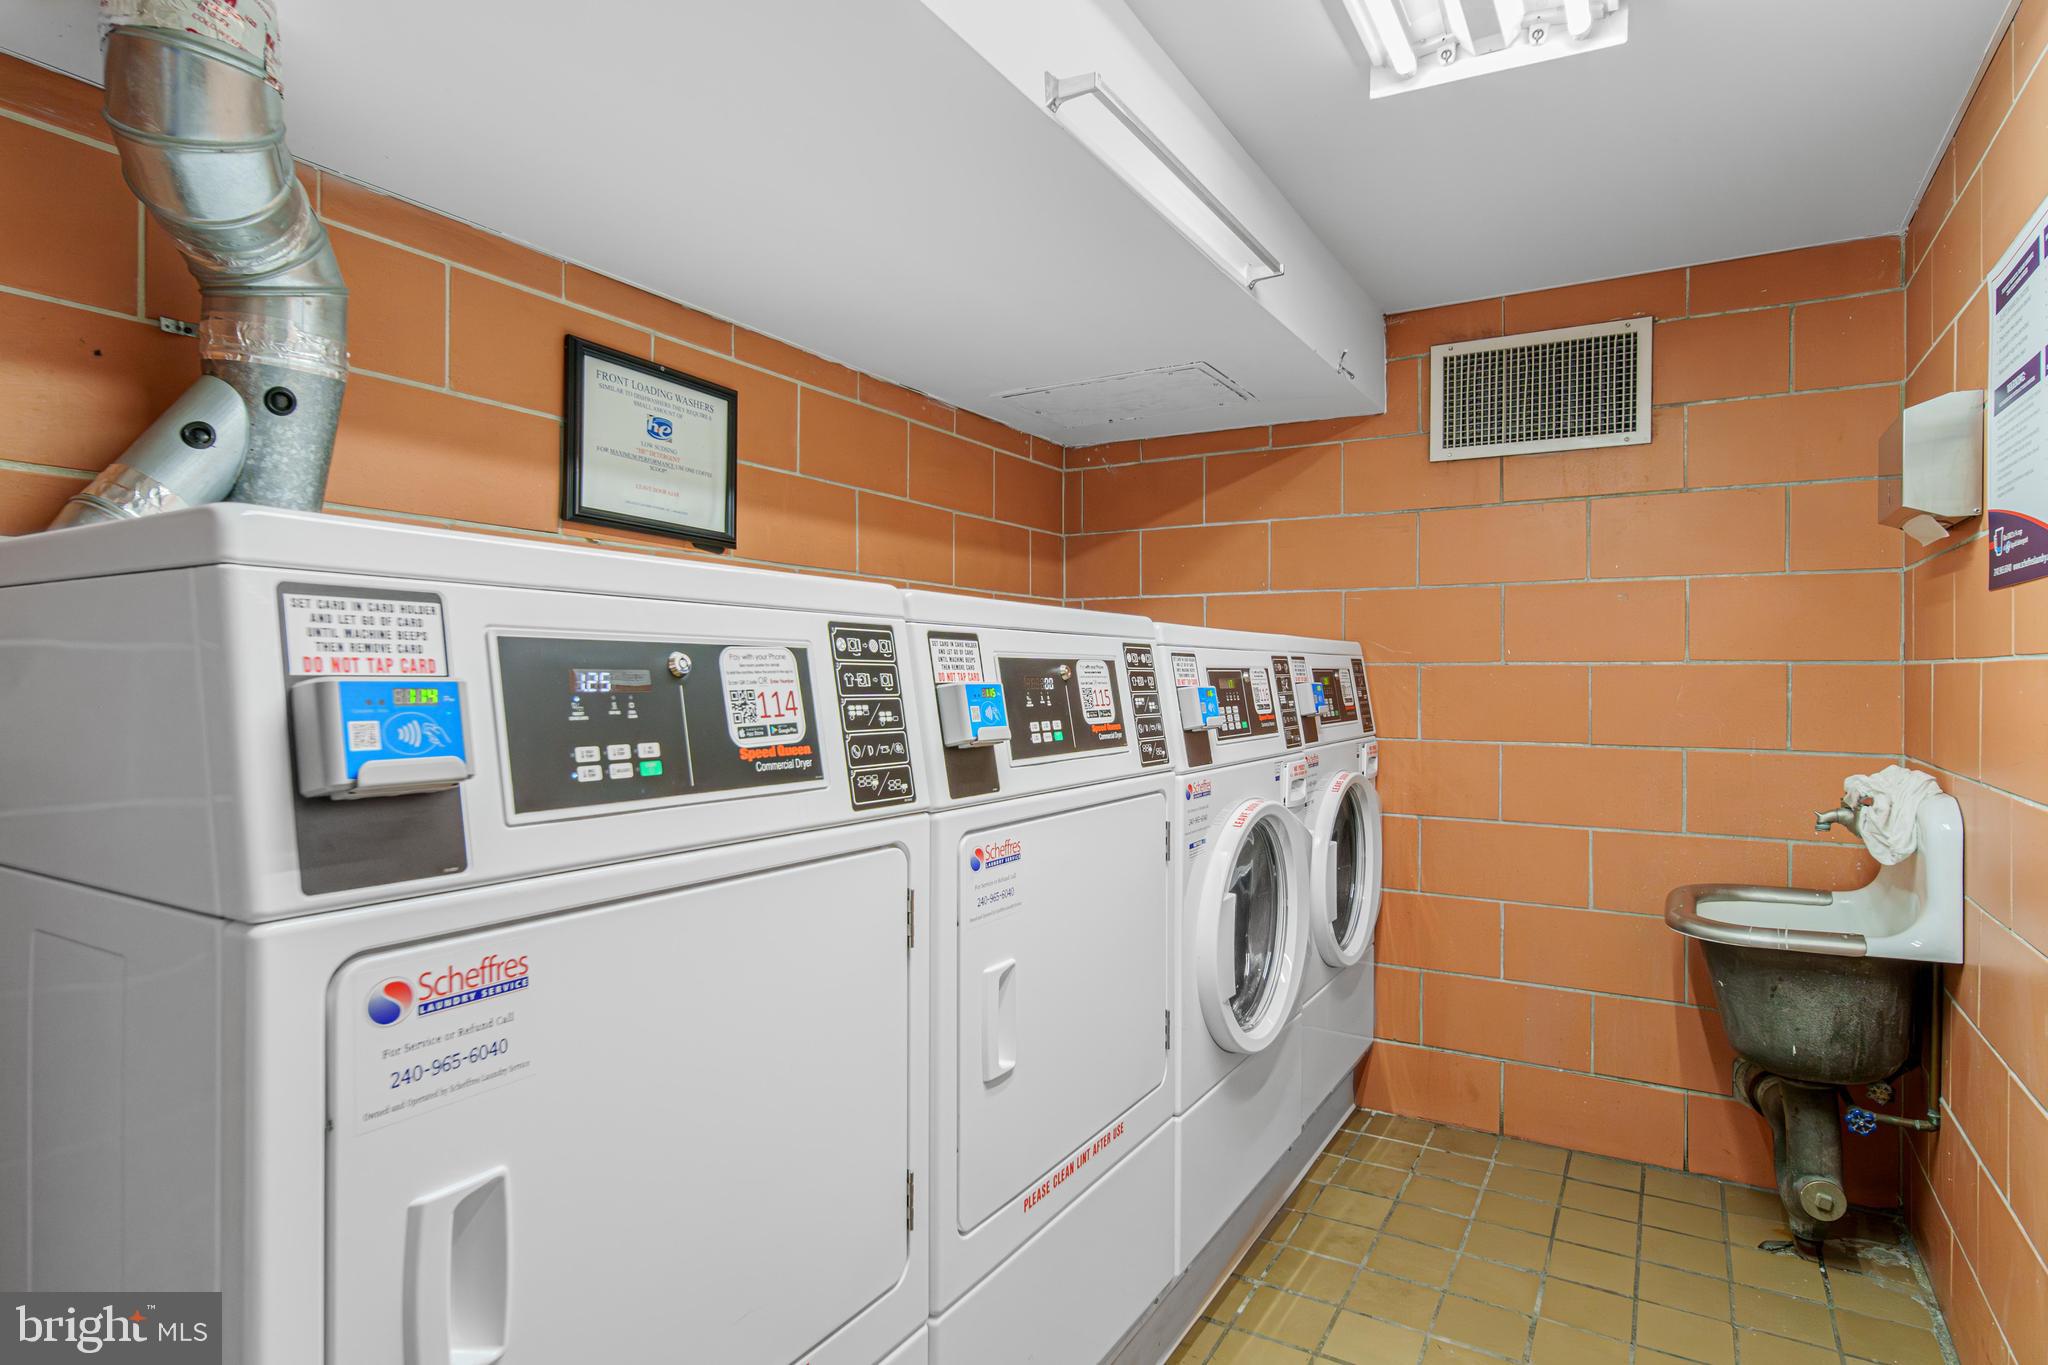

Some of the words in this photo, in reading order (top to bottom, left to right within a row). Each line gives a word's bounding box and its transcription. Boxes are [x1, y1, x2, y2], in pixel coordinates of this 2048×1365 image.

[596, 369, 629, 386] FRONT
[632, 380, 673, 400] LOADING
[675, 393, 714, 413] WASHERS
[599, 383, 623, 394] SIMILAR
[633, 400, 652, 411] SMALL
[596, 445, 609, 453] FOR
[610, 448, 637, 460] MAXIMUM
[289, 598, 310, 608] SET
[317, 599, 346, 611] CARD
[352, 601, 362, 611] IN
[367, 602, 394, 613] CARD
[400, 604, 436, 615] HOLDER
[310, 613, 332, 624] AND
[337, 614, 356, 625] LET
[362, 615, 375, 626] GO
[380, 616, 392, 626] OF
[397, 617, 424, 628] CARD
[307, 627, 338, 638] UNTIL
[344, 628, 391, 640] MACHINE
[397, 630, 428, 641] BEEPS
[316, 641, 343, 652] THEN
[350, 642, 392, 653] REMOVE
[397, 644, 423, 654] CARD
[303, 656, 323, 673] DO
[331, 657, 359, 674] NOT
[366, 657, 393, 673] TAP
[400, 657, 437, 674] CARD
[768, 653, 786, 661] Phone
[938, 672, 945, 681] DO
[946, 672, 955, 681] NOT
[957, 672, 966, 681] TAP
[968, 672, 979, 681] CARD
[757, 690, 798, 718] 114
[1092, 689, 1110, 707] 115
[739, 746, 776, 761] Speed
[777, 744, 812, 757] Queen
[755, 760, 794, 772] Commercial
[795, 758, 812, 770] Dryer
[985, 839, 1021, 861] Scheffres
[418, 954, 529, 1001] Scheffres
[420, 993, 476, 1015] LAUNDRY
[481, 978, 528, 998] SERVICE
[382, 1047, 400, 1060] For
[404, 1036, 441, 1053] Service
[445, 1032, 454, 1041] or
[457, 1018, 493, 1038] Refund
[496, 1012, 514, 1026] Call
[390, 1038, 509, 1089] 240-965-6040
[450, 1077, 480, 1093] Scheffres
[1023, 1181, 1050, 1213] PLEASE
[1053, 1161, 1075, 1189] CLEAN
[1076, 1148, 1090, 1169] LINT
[1093, 1132, 1111, 1157] AFTER
[1112, 1122, 1124, 1140] USE
